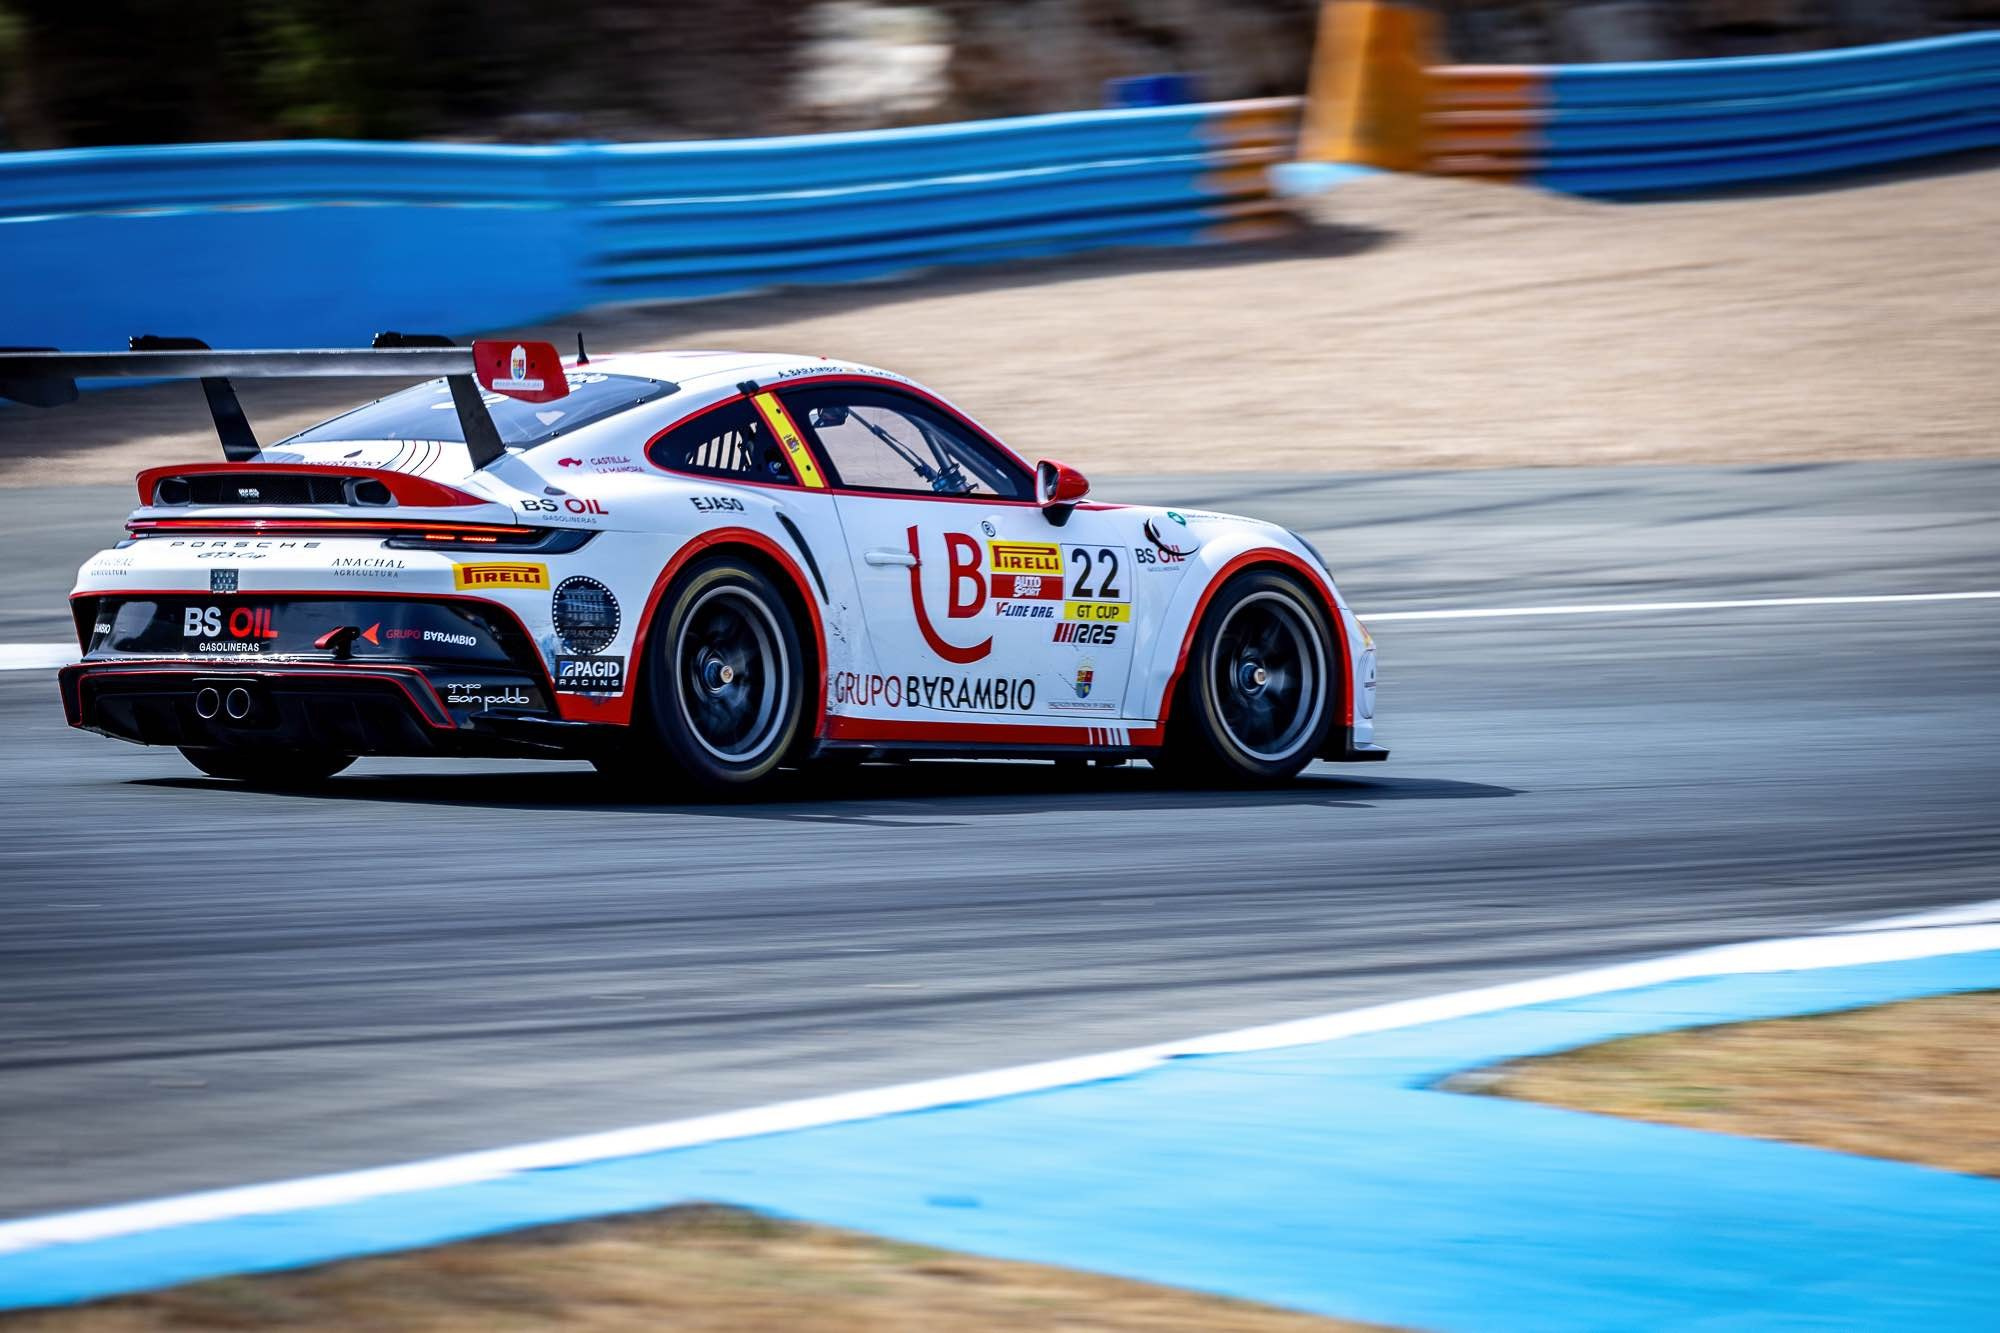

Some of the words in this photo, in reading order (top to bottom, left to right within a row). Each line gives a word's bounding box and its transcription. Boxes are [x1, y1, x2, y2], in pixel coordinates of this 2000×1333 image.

[520, 499, 559, 513] BS
[564, 498, 609, 515] OIL
[689, 496, 745, 512] EJASO
[170, 541, 321, 549] PORSCHE
[197, 551, 236, 559] GT3
[237, 551, 267, 560] Cup
[992, 545, 1060, 571] PIRELLI
[1134, 547, 1157, 564] BS
[1157, 544, 1186, 563] OIL
[331, 557, 406, 570] ANACHAL
[333, 569, 399, 579] AGRICULTURA
[463, 565, 541, 585] PIRELLI
[1071, 547, 1120, 598] 22
[1014, 575, 1042, 588] AUTO
[995, 602, 1030, 617] V-LINE
[1076, 604, 1092, 618] GT
[1096, 604, 1120, 619] CUP
[183, 606, 222, 638] BS
[228, 606, 280, 639] OIL
[385, 629, 421, 640] GRUPO
[199, 642, 260, 652] GASOLINERAS
[574, 661, 620, 677] PAGID
[447, 683, 482, 694] grupo
[558, 678, 620, 687] RACING
[447, 693, 482, 704] san
[484, 687, 530, 711] pablo
